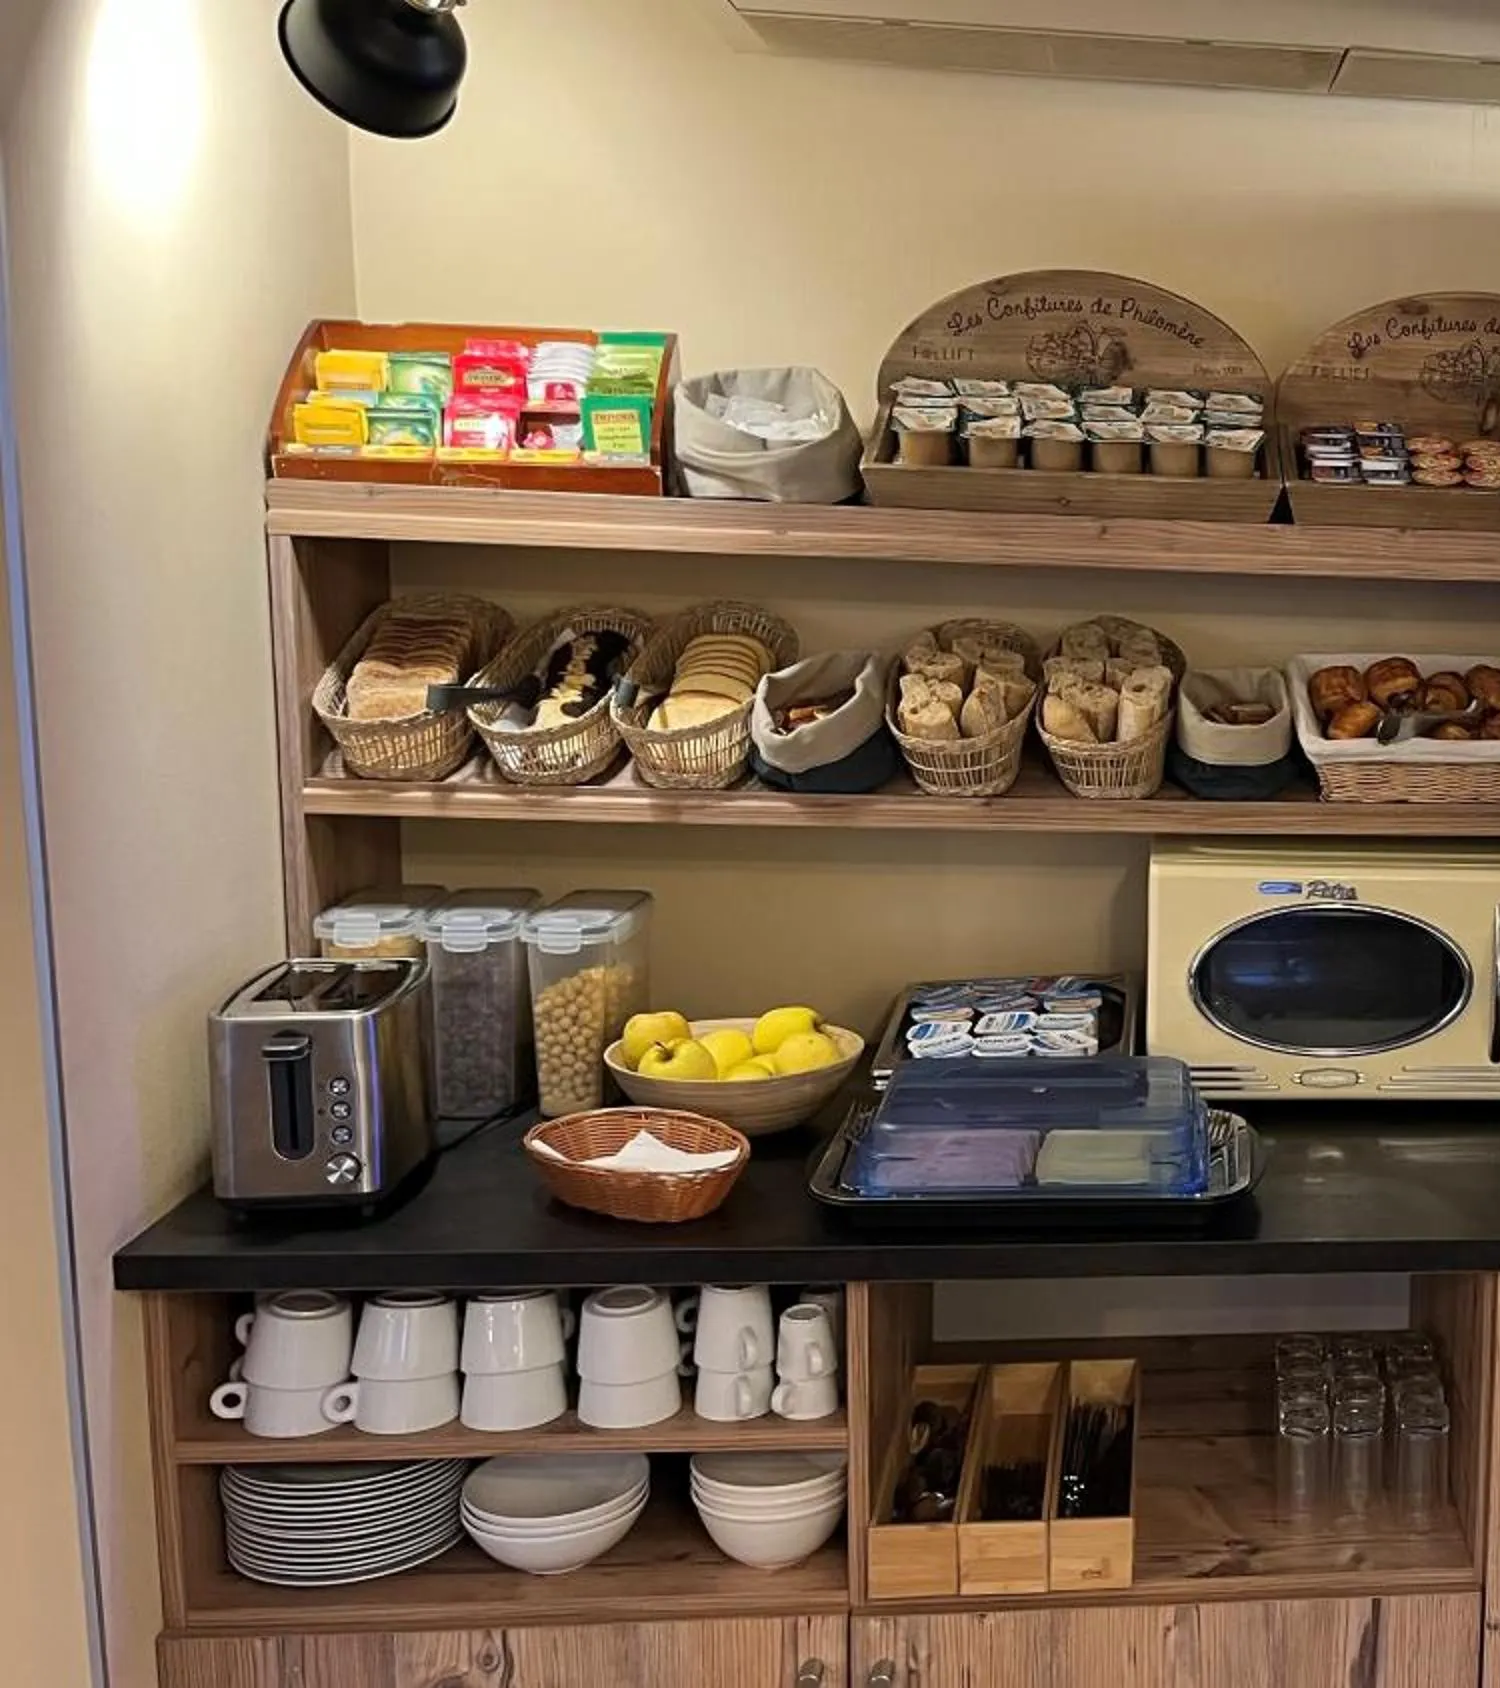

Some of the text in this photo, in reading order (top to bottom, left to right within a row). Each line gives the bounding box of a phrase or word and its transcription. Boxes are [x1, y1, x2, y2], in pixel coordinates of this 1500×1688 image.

[947, 311, 983, 337] Les
[986, 296, 1083, 321] Confitures
[1090, 297, 1112, 316] de
[1347, 331, 1381, 359] Les
[1385, 316, 1477, 340] Confitures
